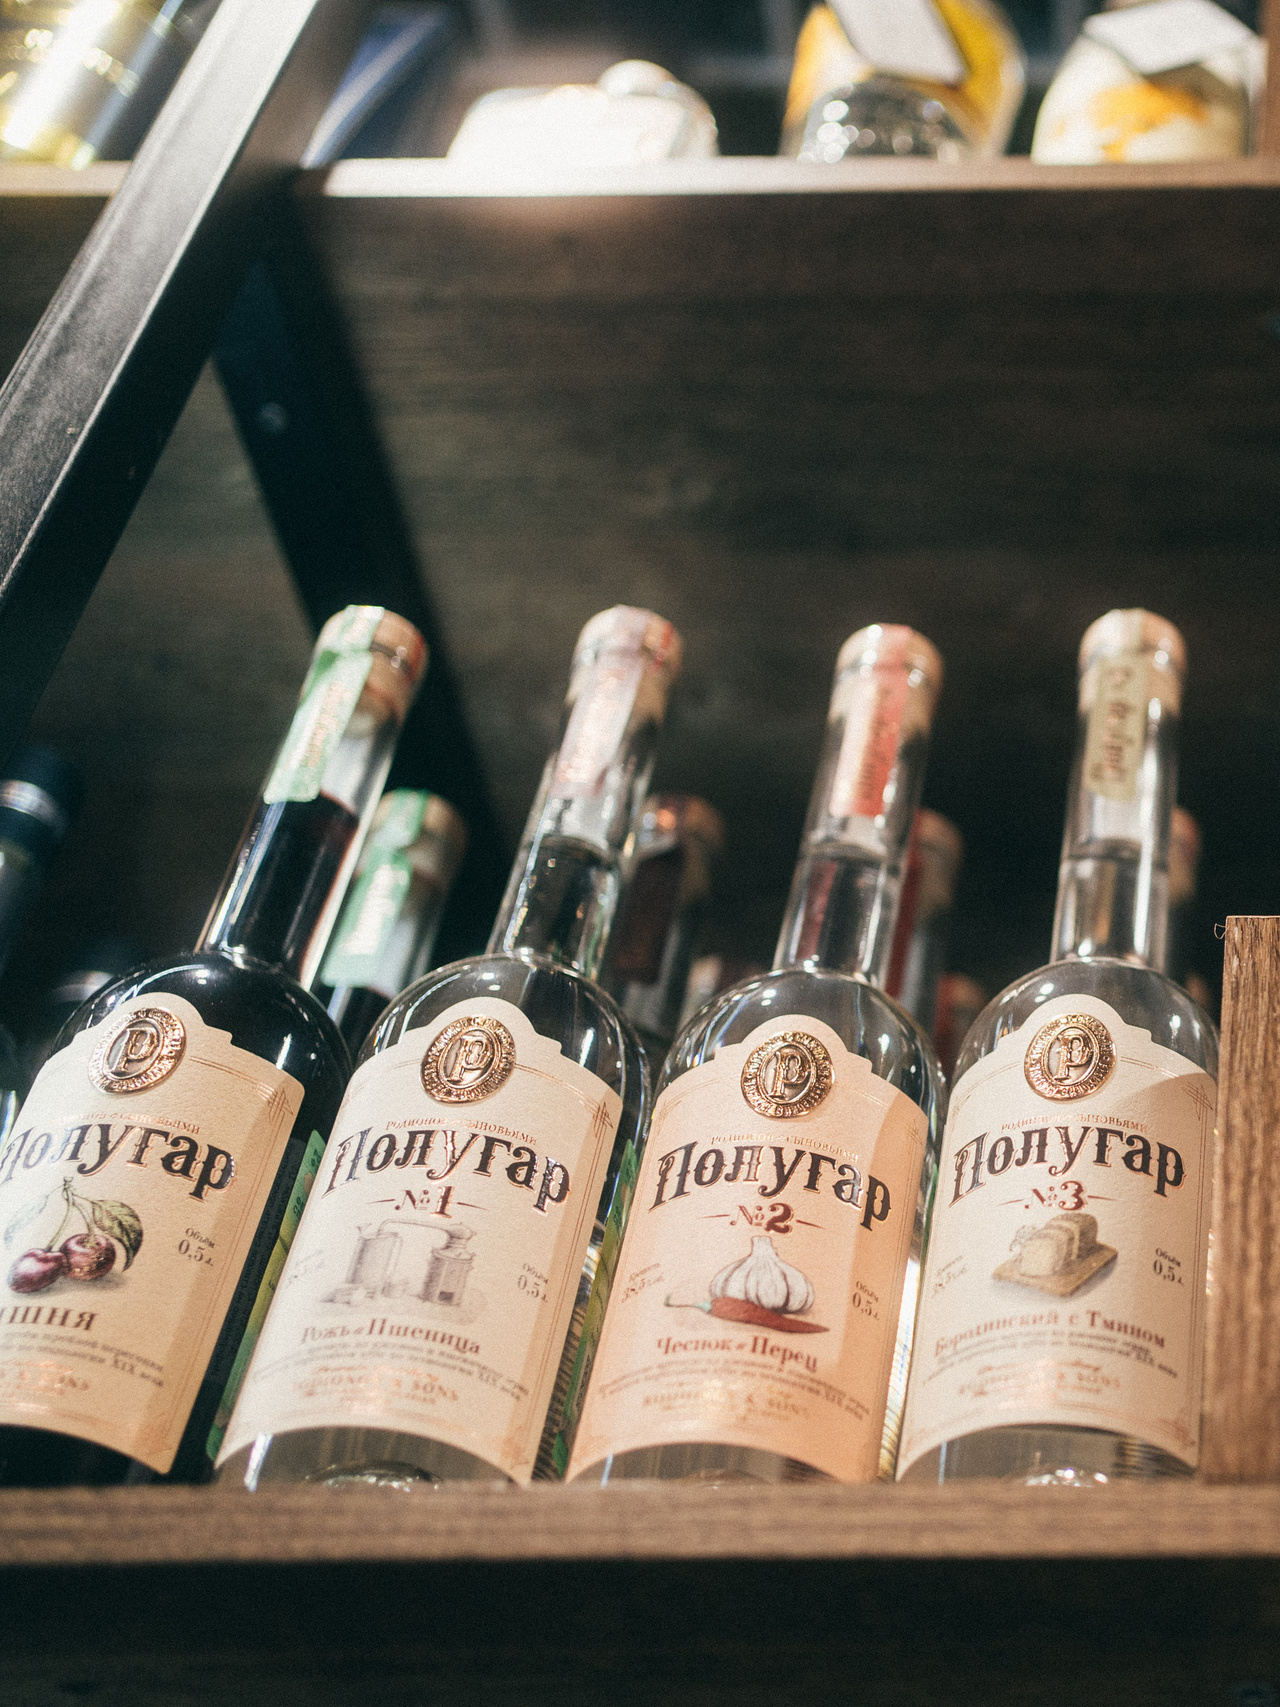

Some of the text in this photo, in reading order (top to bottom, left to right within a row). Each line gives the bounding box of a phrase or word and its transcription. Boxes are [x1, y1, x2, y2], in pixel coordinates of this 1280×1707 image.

[0, 1122, 239, 1204] Полугар
[321, 1126, 572, 1217] Полугар
[648, 1140, 893, 1232] Полугар
[948, 1125, 1188, 1209] Полугар
[0, 1305, 98, 1331] шня
[366, 1317, 481, 1355] Пшеница
[657, 1335, 733, 1355] Чеснок
[749, 1334, 818, 1374] Перец
